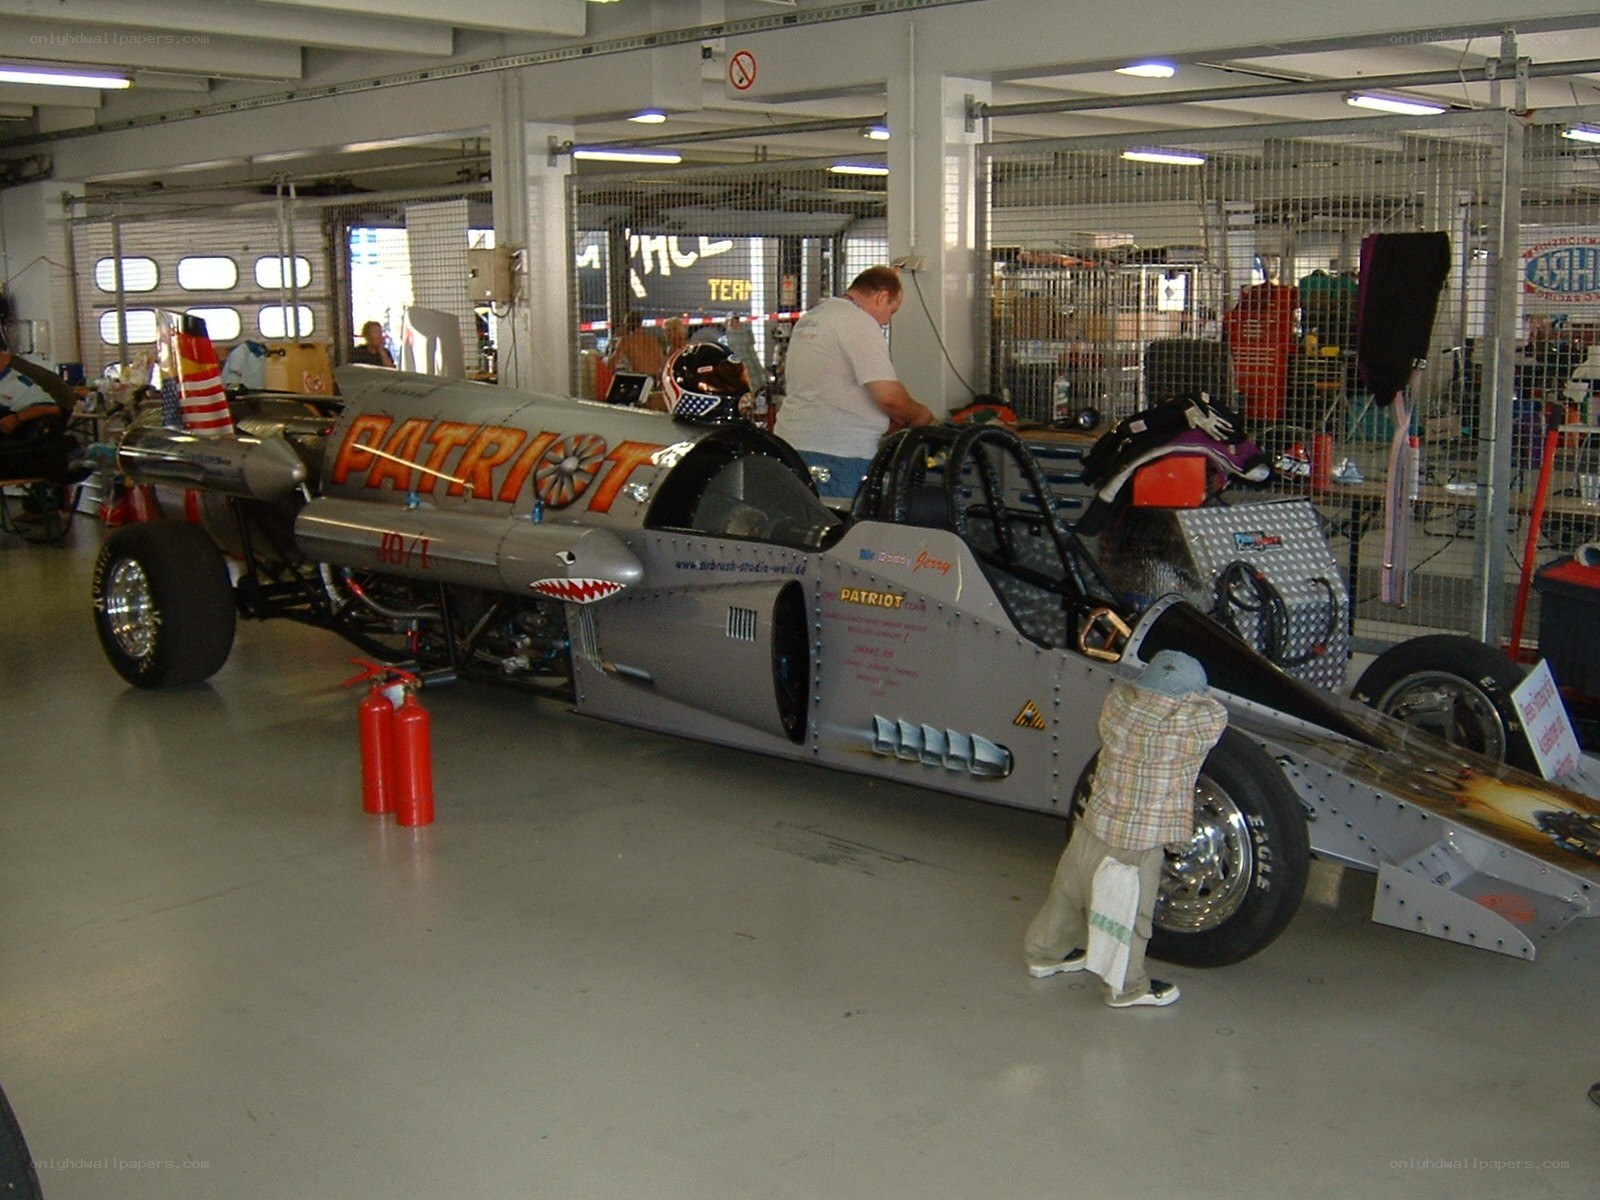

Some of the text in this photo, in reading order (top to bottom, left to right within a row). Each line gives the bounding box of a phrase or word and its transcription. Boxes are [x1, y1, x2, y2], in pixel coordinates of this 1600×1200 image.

[331, 413, 671, 513] PATRIOT
[912, 550, 951, 576] Jerry
[840, 587, 904, 609] PATRIOT
